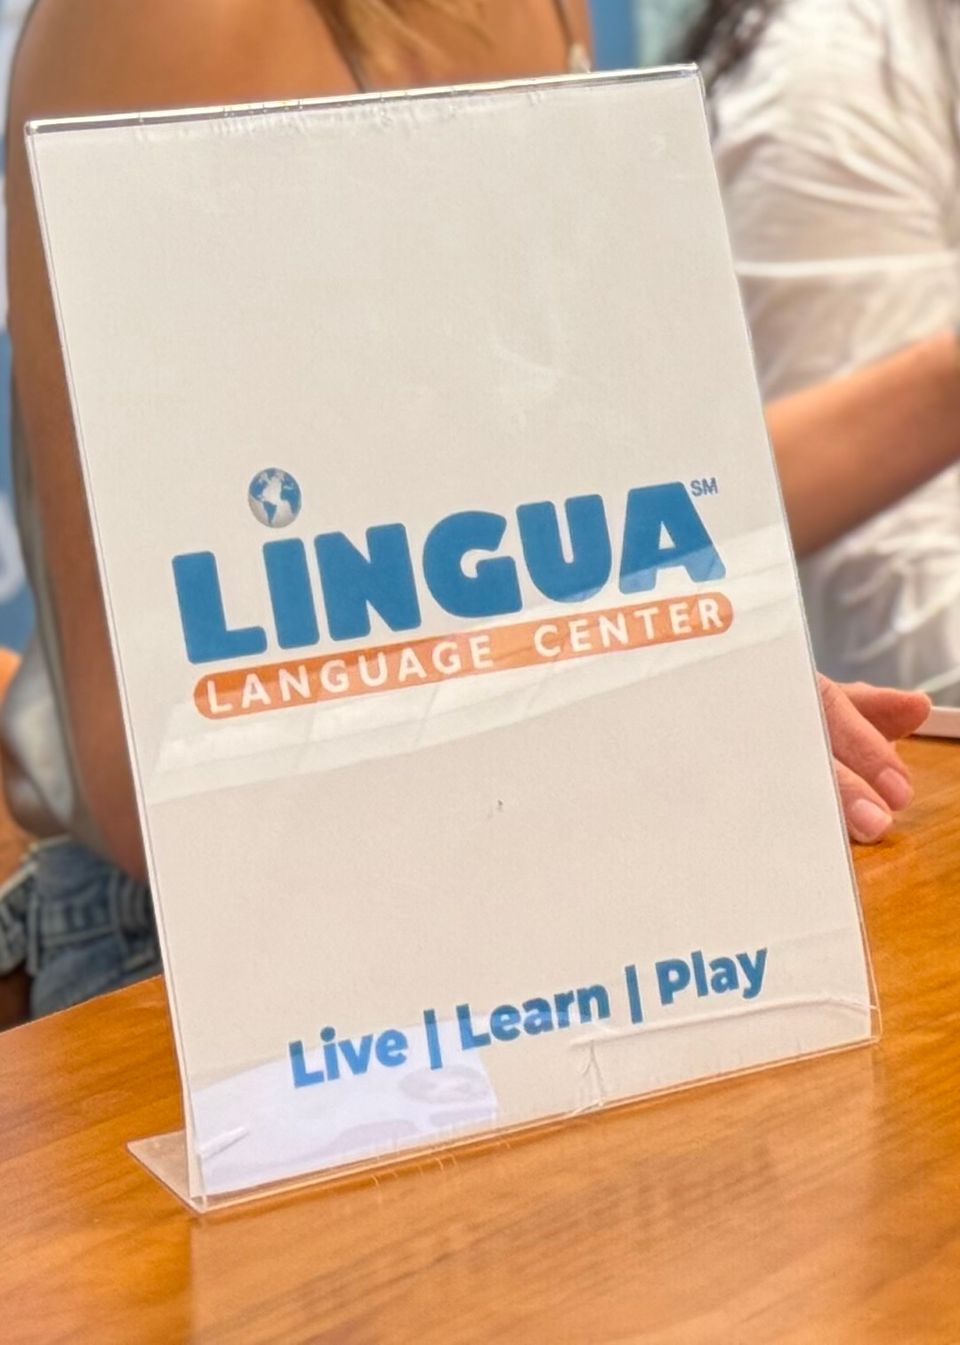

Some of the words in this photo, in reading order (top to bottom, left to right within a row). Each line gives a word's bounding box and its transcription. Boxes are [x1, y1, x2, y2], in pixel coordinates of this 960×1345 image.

[171, 480, 727, 665] LINGUA
[206, 635, 494, 715] LANGUAGE
[533, 599, 725, 657] CENTER
[288, 1025, 408, 1088] Live
[458, 984, 610, 1052] Learn
[656, 947, 768, 1005] Play
